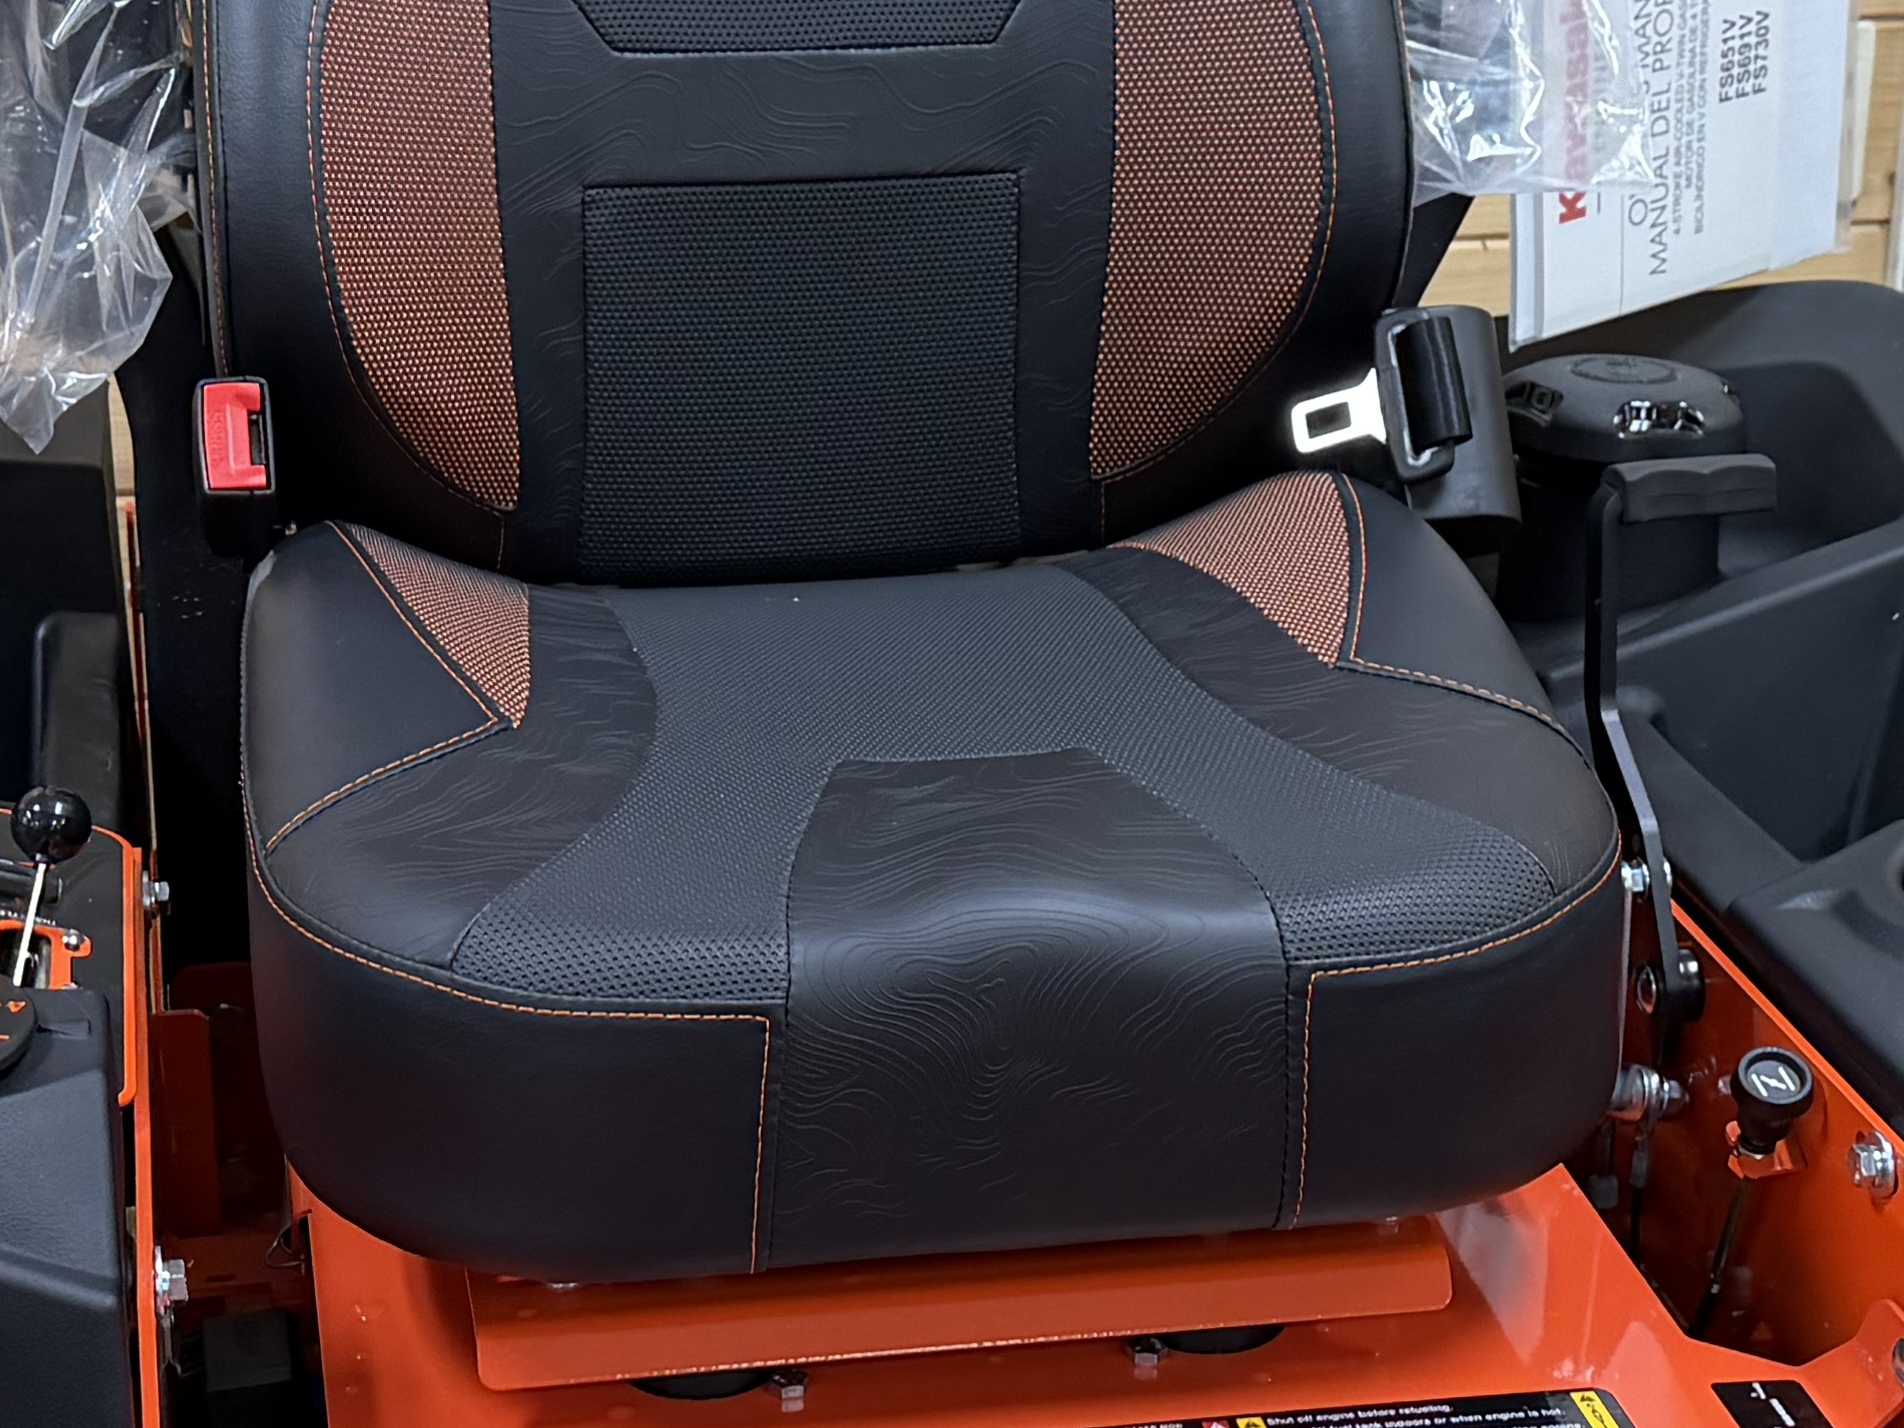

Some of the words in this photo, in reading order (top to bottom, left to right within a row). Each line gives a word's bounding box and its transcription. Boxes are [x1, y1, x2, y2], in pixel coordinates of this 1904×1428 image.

[1719, 18, 1737, 103] FS651V
[1736, 14, 1754, 99] FS691V
[1753, 10, 1770, 94] FS730V
[1650, 83, 1671, 136] DEL
[1648, 146, 1670, 275] MANUAL
